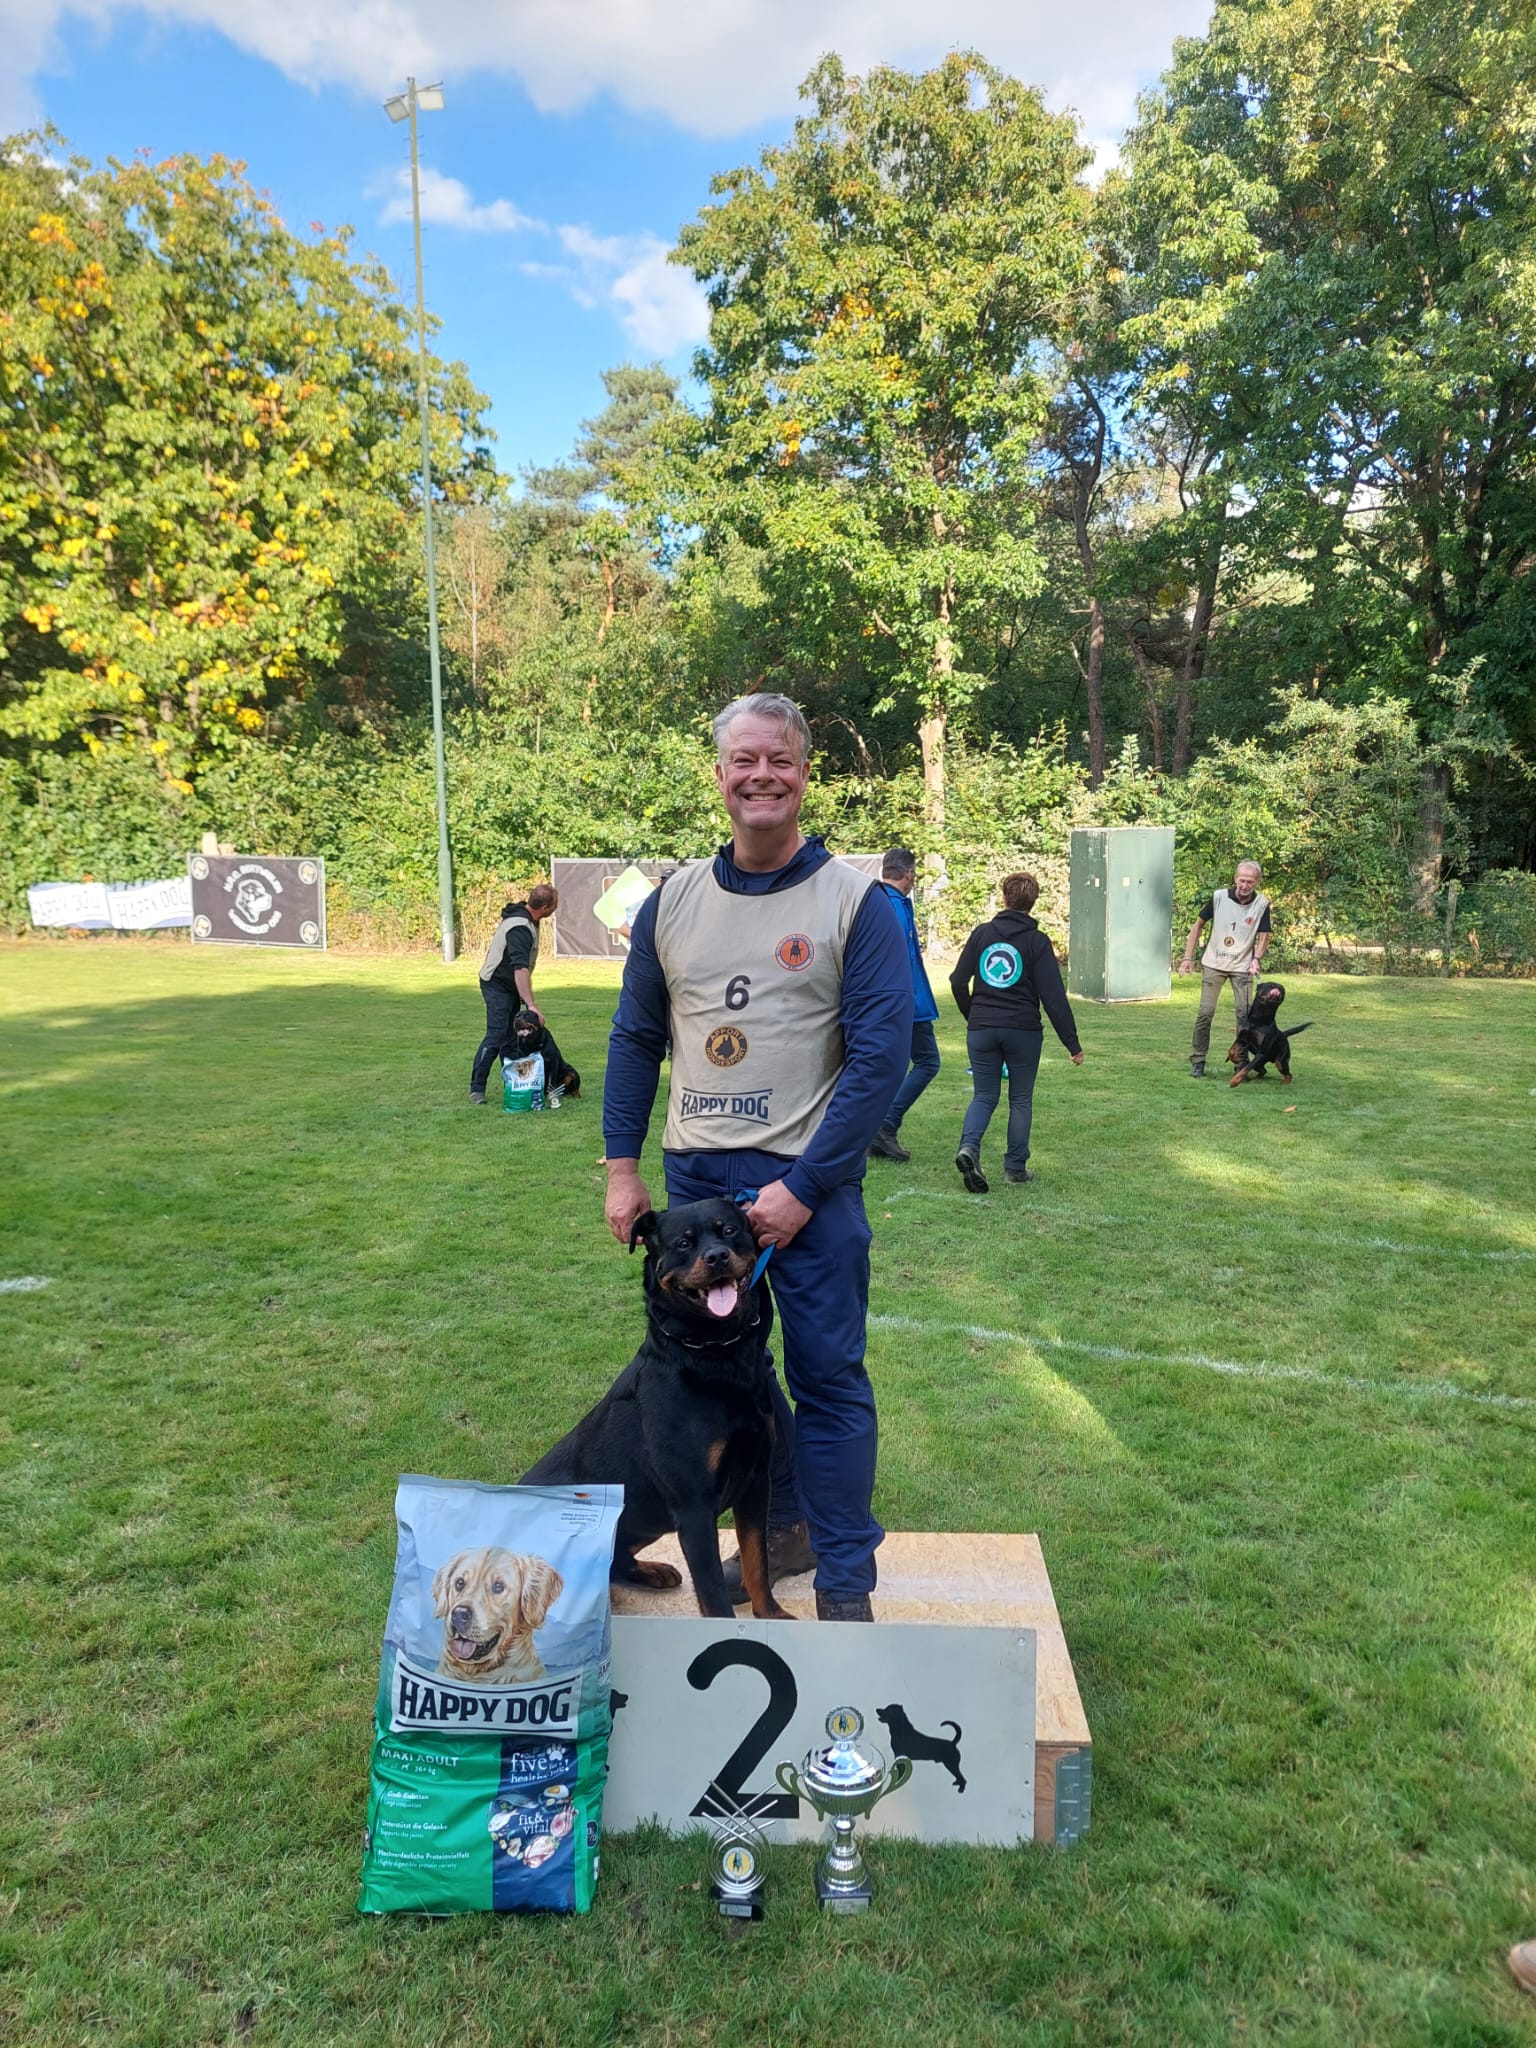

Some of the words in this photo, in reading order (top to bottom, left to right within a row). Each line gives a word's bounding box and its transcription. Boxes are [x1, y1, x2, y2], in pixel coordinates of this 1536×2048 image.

[1230, 921, 1237, 932] 1
[725, 974, 751, 1011] 6
[710, 1028, 745, 1041] APPORT
[681, 1093, 728, 1116] HAPPY
[731, 1095, 769, 1120] DOG
[399, 1675, 502, 1723] HAPPY
[504, 1686, 573, 1724] DOG
[687, 1638, 800, 1819] 2
[381, 1748, 414, 1761] MAXI
[417, 1754, 460, 1768] ADULT
[511, 1752, 547, 1772] five
[523, 1819, 549, 1835] vital
